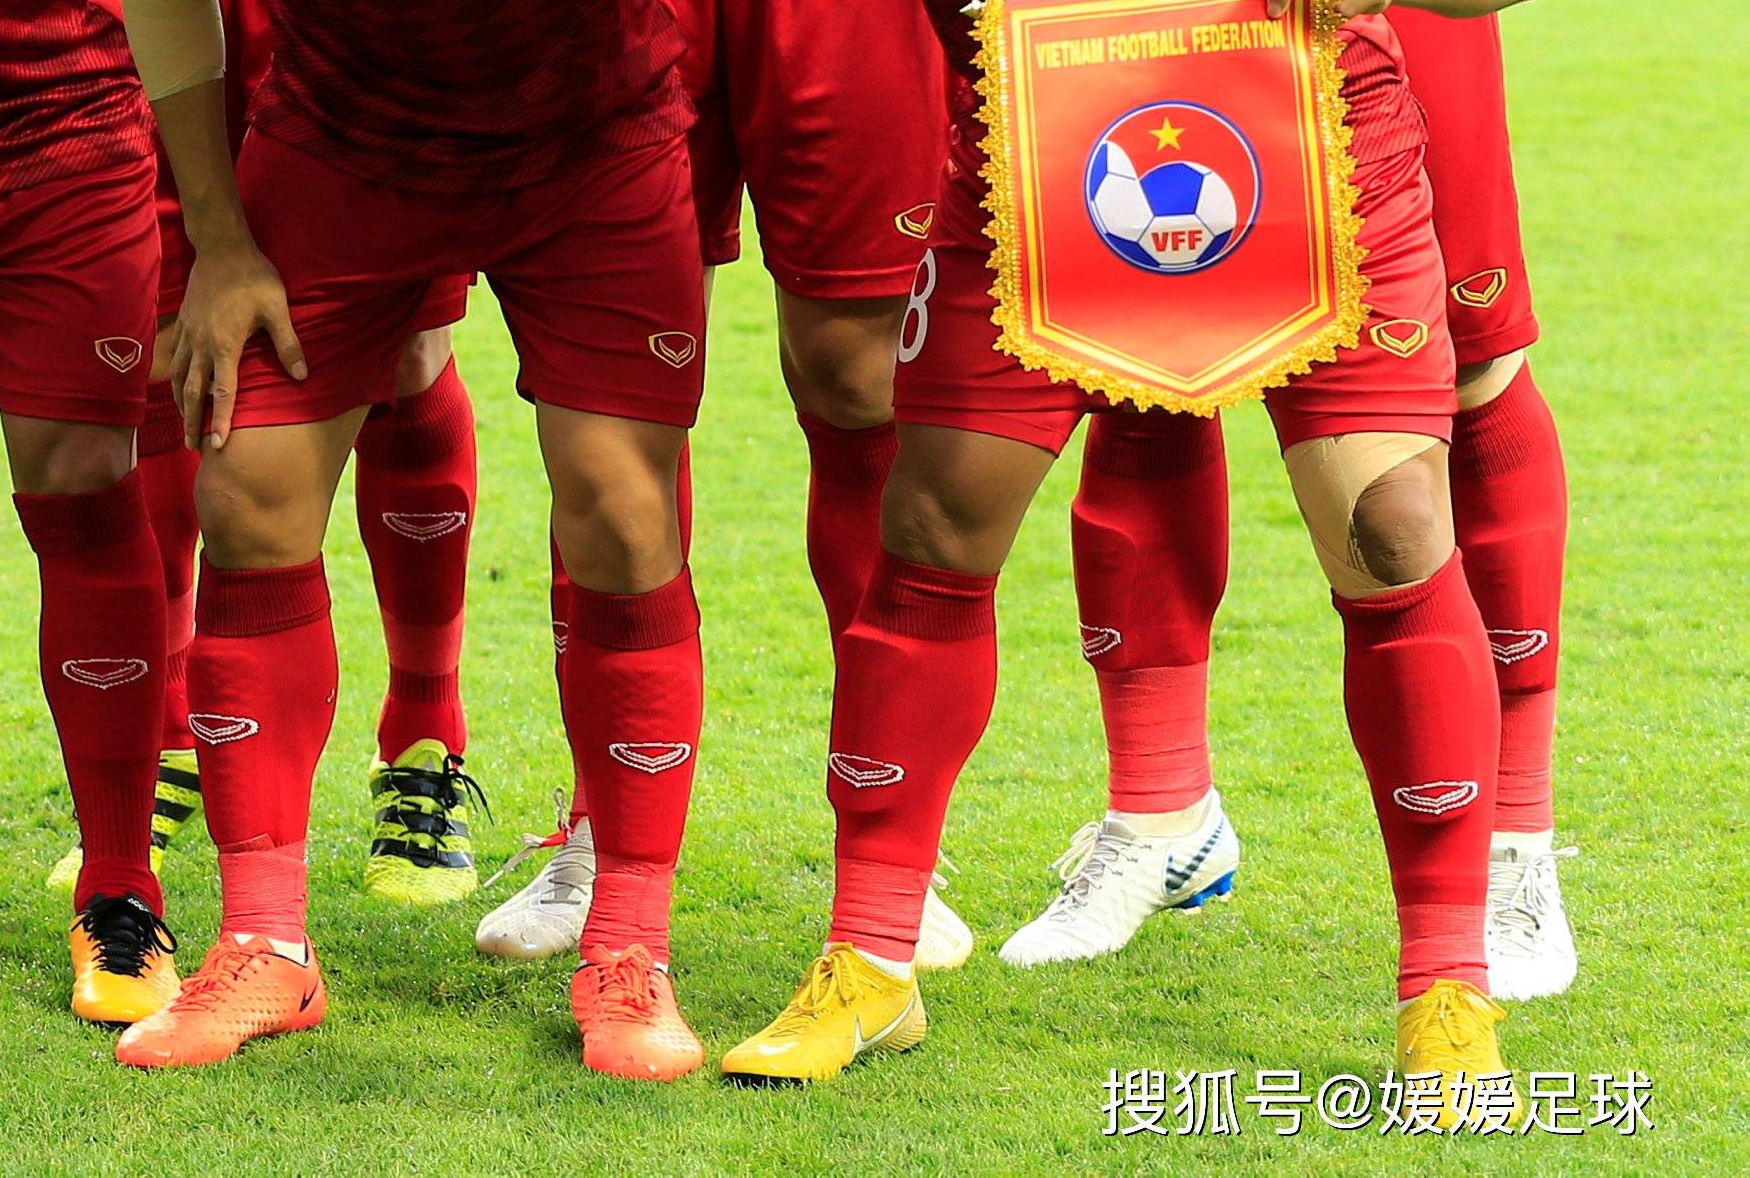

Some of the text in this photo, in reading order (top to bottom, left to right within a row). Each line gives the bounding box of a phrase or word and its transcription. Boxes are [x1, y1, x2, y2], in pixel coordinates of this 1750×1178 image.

[1035, 19, 1286, 70] VIETNAM FOOTBALL FEDERATION
[1150, 229, 1203, 252] VFF
[898, 247, 937, 363] 8
